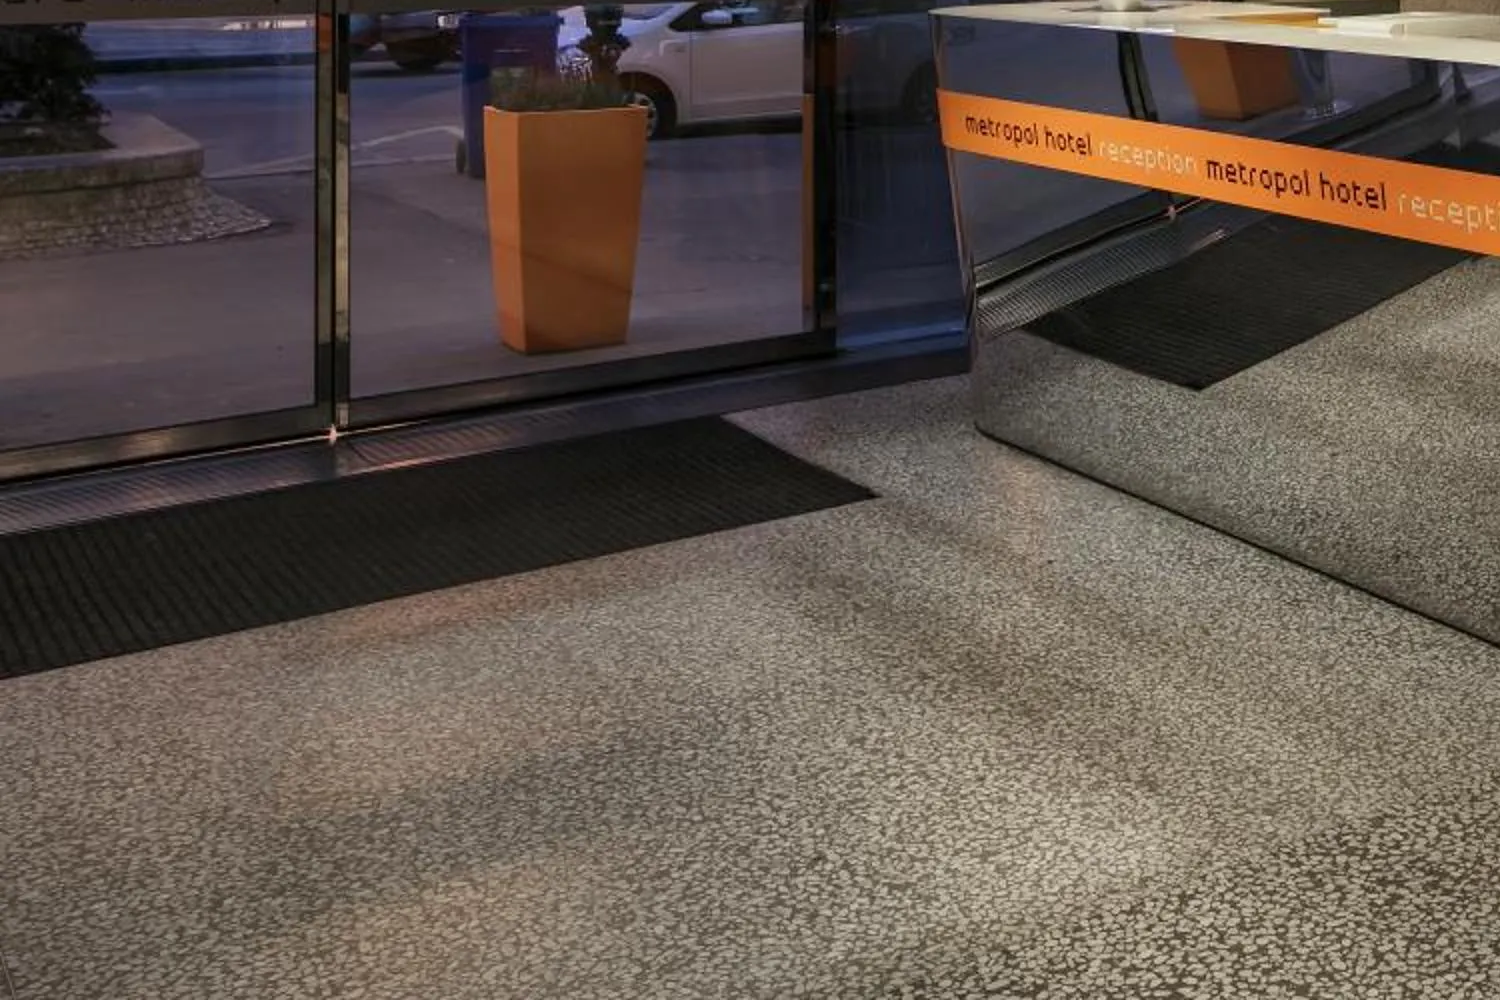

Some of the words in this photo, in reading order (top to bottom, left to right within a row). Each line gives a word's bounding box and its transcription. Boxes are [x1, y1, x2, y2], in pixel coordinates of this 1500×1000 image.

[965, 115, 1039, 146] metropol
[1044, 129, 1092, 156] hotel
[1100, 140, 1198, 177] reception
[1206, 159, 1311, 198] metropol
[1319, 171, 1387, 211] hotel
